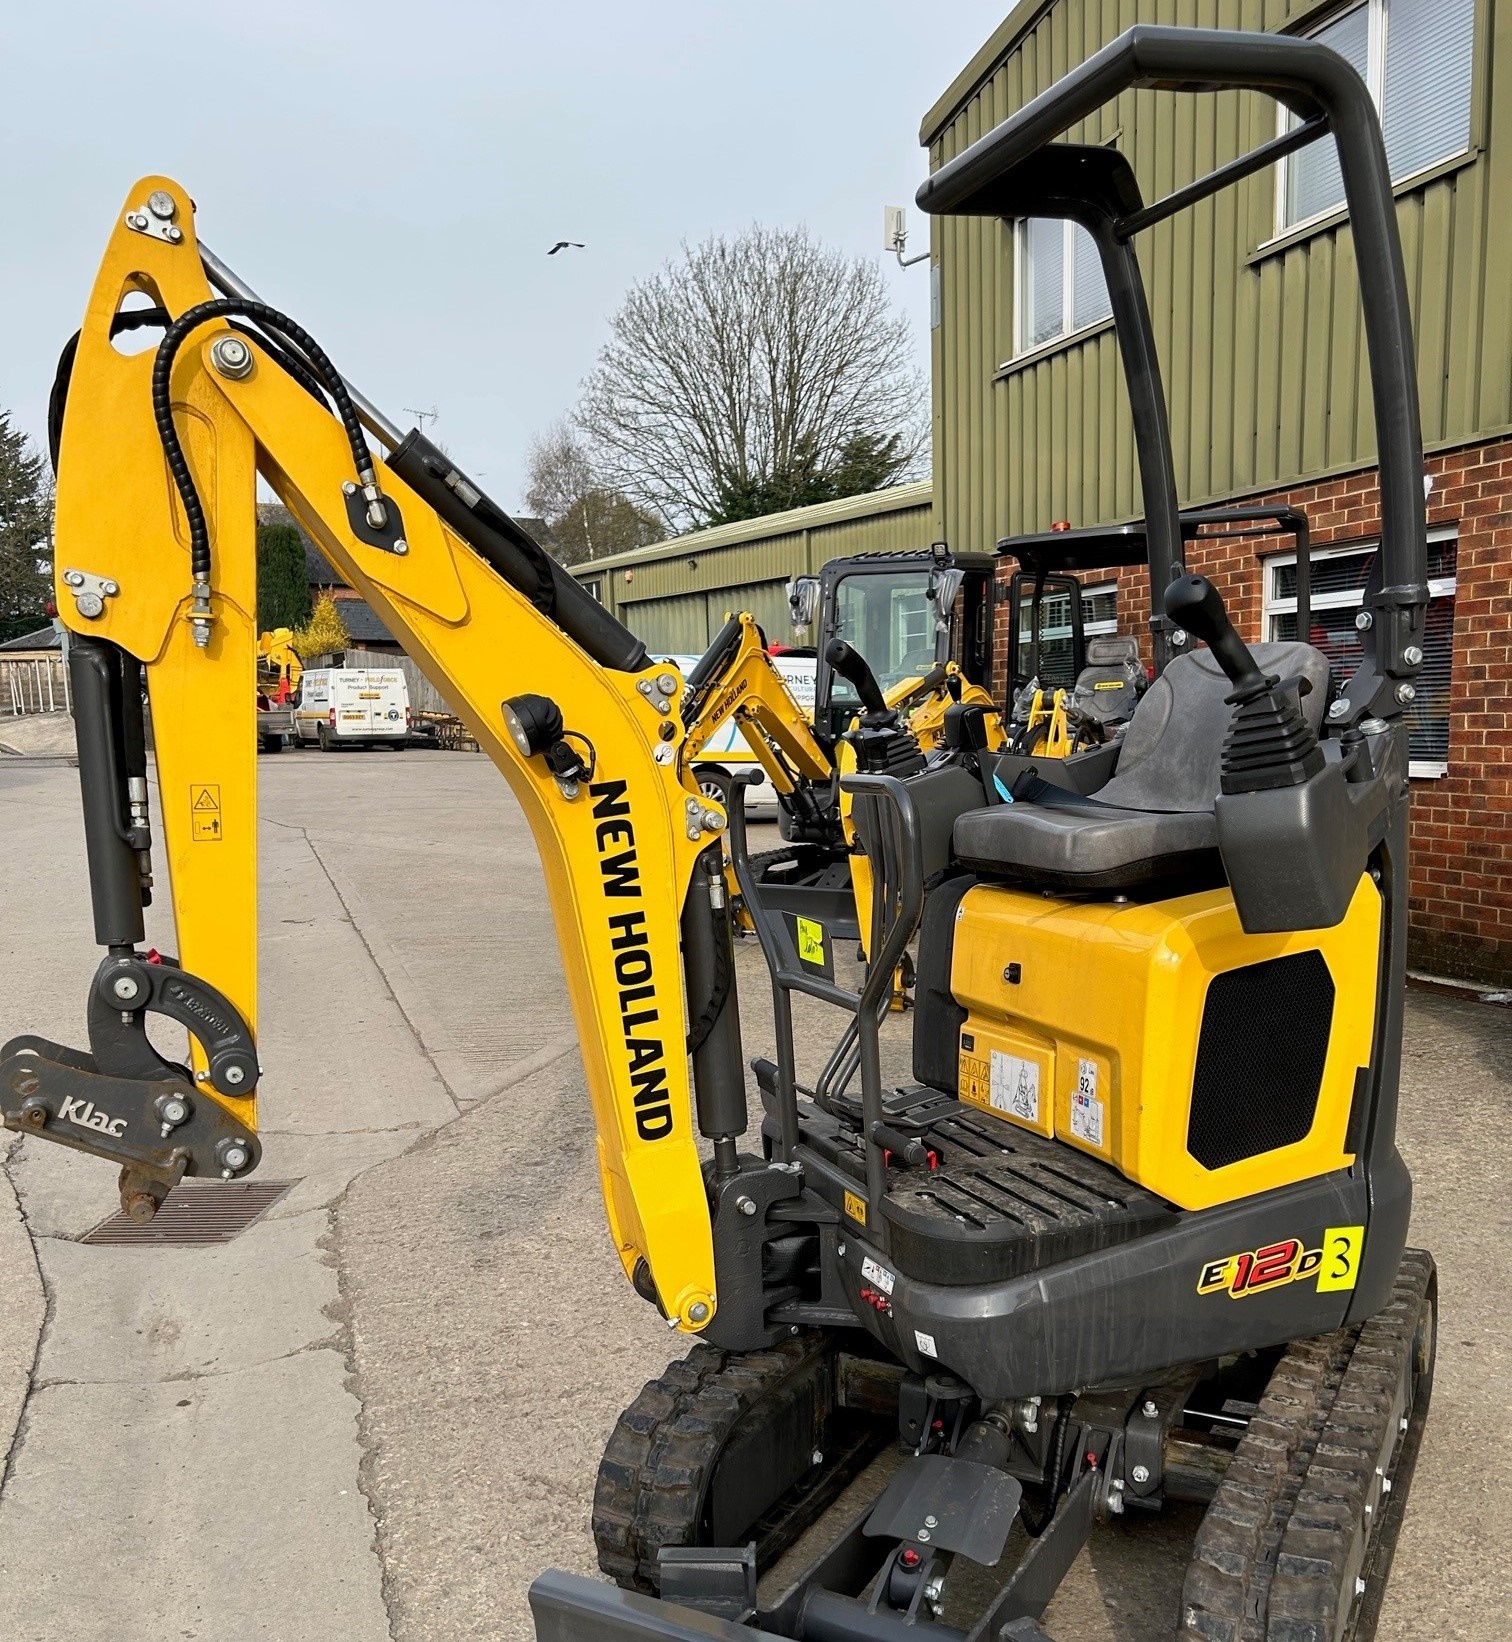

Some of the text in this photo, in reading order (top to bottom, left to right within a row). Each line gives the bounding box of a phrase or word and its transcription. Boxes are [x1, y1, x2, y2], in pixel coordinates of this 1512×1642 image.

[784, 675, 817, 685] RNEY
[711, 679, 748, 724] NEW HOLLAND
[588, 779, 674, 1142] NEW HOLLAND
[1080, 1076, 1090, 1093] 92
[58, 1095, 128, 1138] Klac
[1331, 1237, 1351, 1279] 3
